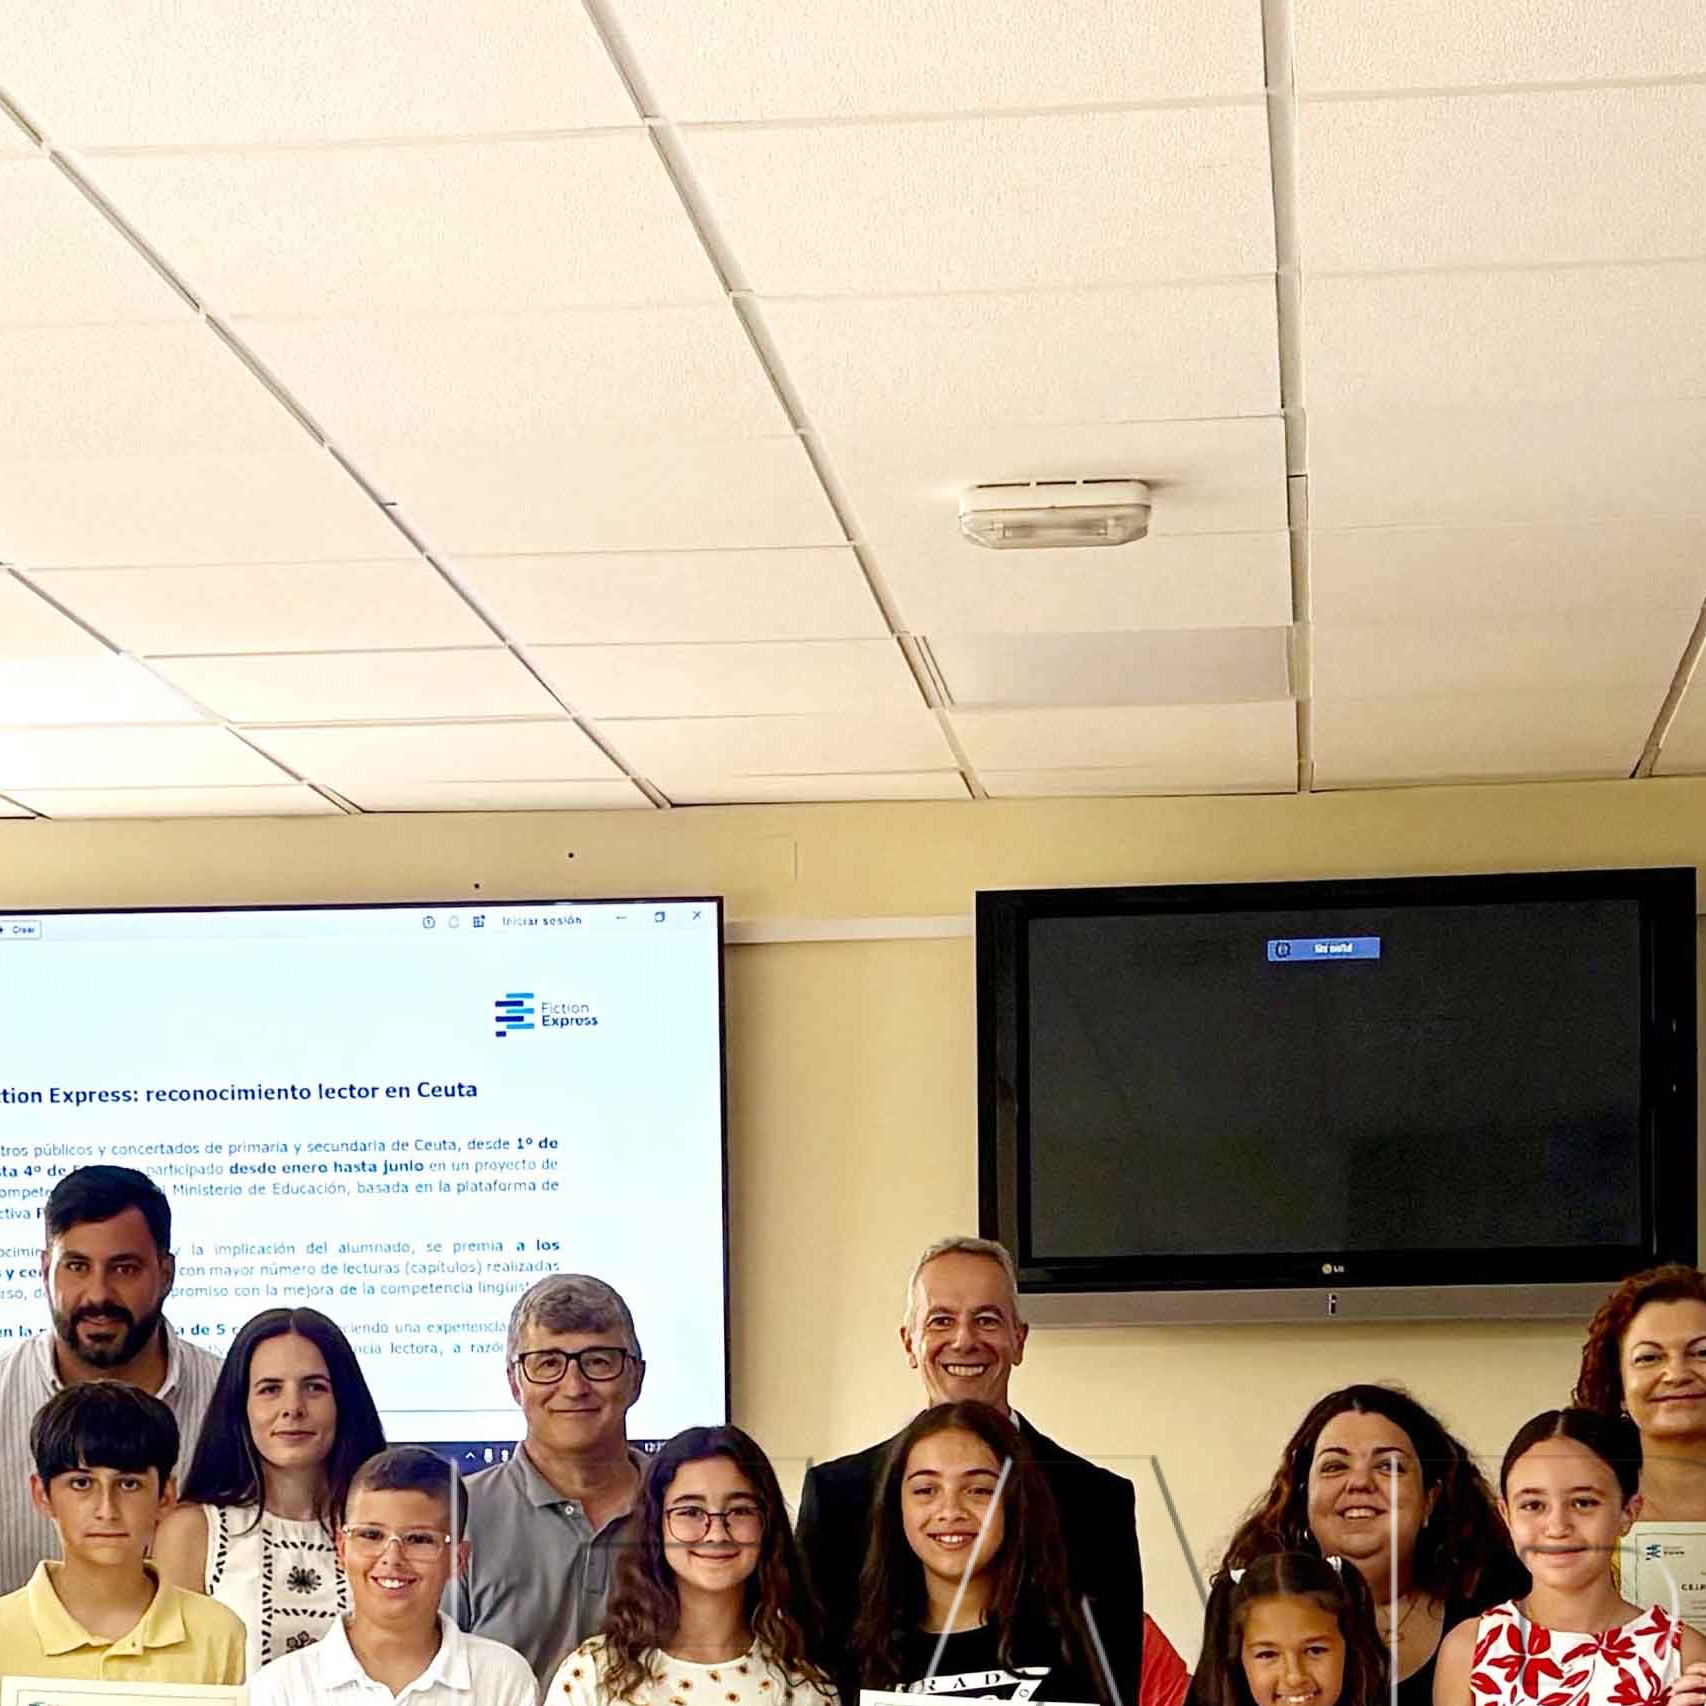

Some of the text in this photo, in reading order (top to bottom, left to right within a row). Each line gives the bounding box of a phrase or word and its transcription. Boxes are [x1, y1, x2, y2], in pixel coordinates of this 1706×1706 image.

[503, 914, 582, 926] Iniciar sesión
[541, 1001, 590, 1014] Fiction
[542, 1014, 598, 1029] Express
[49, 1085, 140, 1107] Express:
[146, 1086, 312, 1102] reconocimiento
[318, 1082, 379, 1099] lector
[385, 1086, 411, 1099] en
[417, 1081, 478, 1098] Ceuta
[34, 1142, 92, 1160] públicos
[98, 1145, 106, 1159] y
[111, 1140, 199, 1155] concertados
[204, 1140, 222, 1154] de
[228, 1140, 288, 1157] primaria
[293, 1143, 301, 1156] y
[307, 1138, 385, 1152] secundaria
[391, 1138, 409, 1151] de
[467, 1136, 510, 1150] desde
[538, 1136, 558, 1149] de
[47, 1163, 67, 1176] de
[5, 1268, 15, 1282] y
[18, 1324, 33, 1337] la
